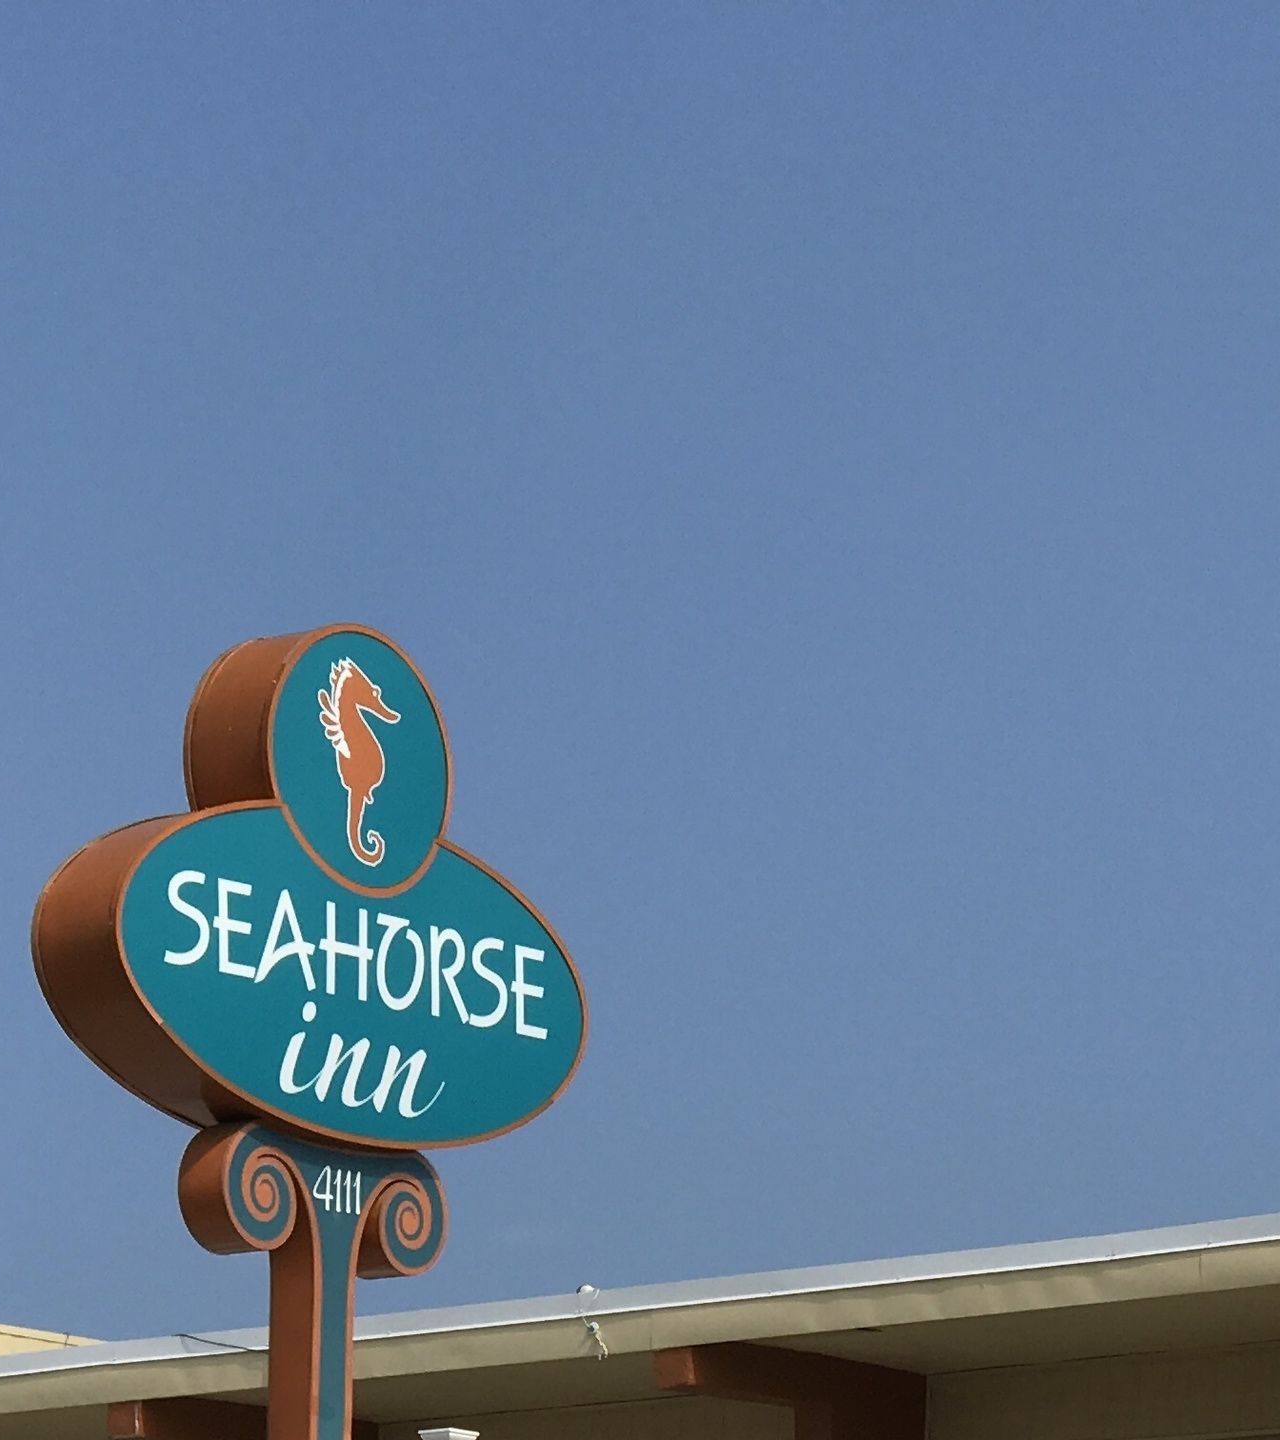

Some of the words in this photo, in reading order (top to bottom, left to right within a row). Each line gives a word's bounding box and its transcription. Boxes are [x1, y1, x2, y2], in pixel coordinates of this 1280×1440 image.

[162, 869, 548, 1041] SEAHORSE
[278, 1001, 446, 1118] inn
[312, 1164, 362, 1216] 4111
